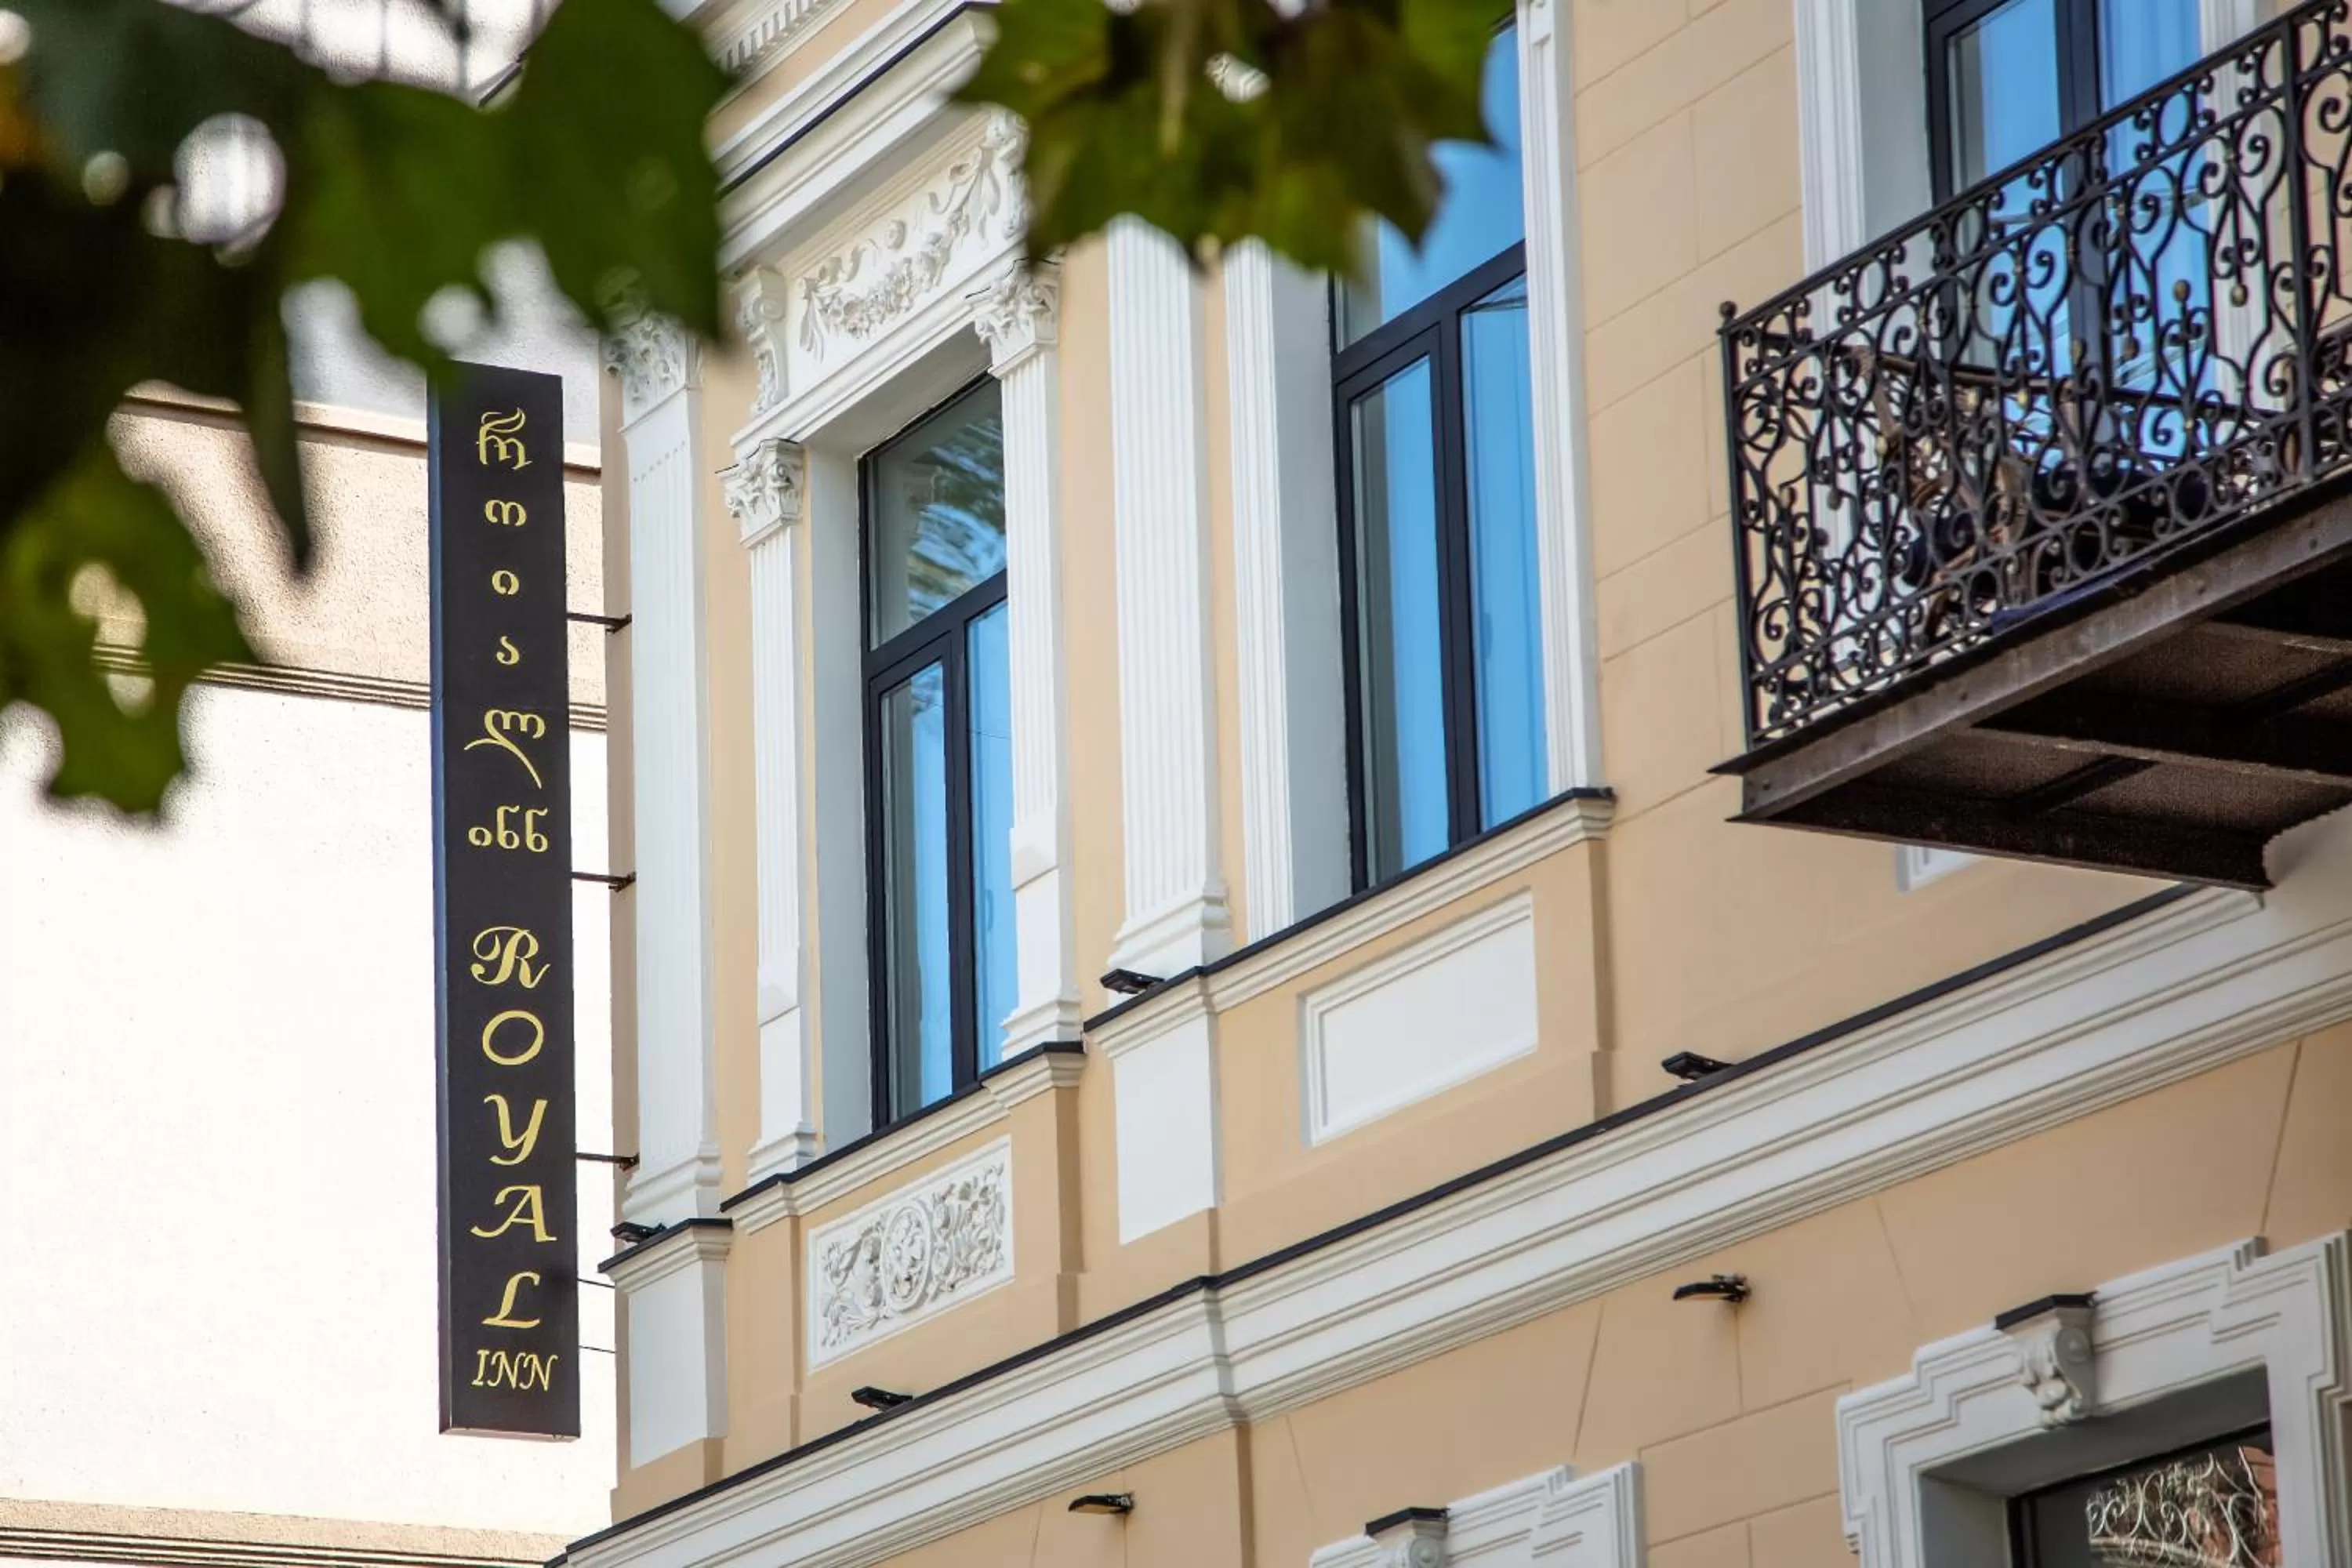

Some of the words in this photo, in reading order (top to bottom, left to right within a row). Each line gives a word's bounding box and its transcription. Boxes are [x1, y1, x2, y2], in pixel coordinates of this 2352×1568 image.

[468, 804, 549, 853] ინნ
[470, 926, 557, 1329] ROYAL
[472, 1348, 558, 1392] INN
